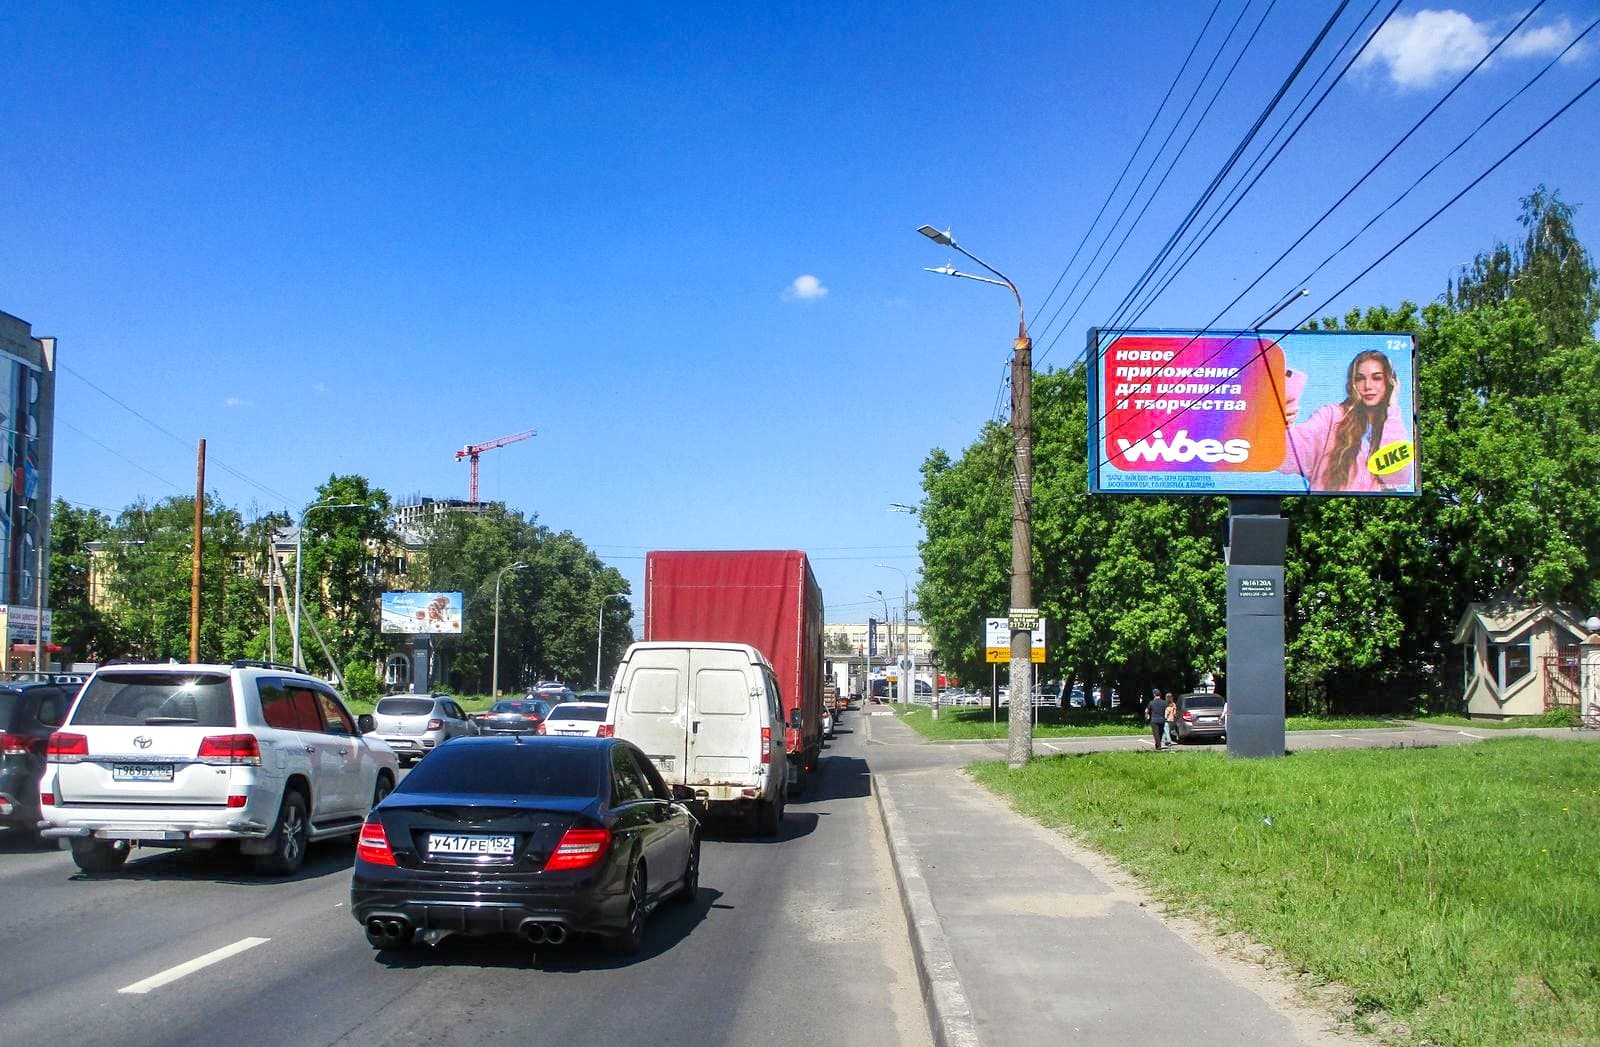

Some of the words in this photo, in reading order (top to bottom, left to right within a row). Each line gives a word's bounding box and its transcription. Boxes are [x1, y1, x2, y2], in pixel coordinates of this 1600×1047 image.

[1386, 340, 1408, 350] 12+
[1116, 350, 1175, 361] новое
[1116, 366, 1240, 381] приложение
[1115, 383, 1152, 396] для
[1156, 383, 1242, 395] шопинга
[1116, 399, 1129, 410] и
[1134, 399, 1247, 414] творчества
[1375, 445, 1410, 471] LIKE
[434, 836, 487, 851] У417РЕ
[490, 837, 511, 848] 152
